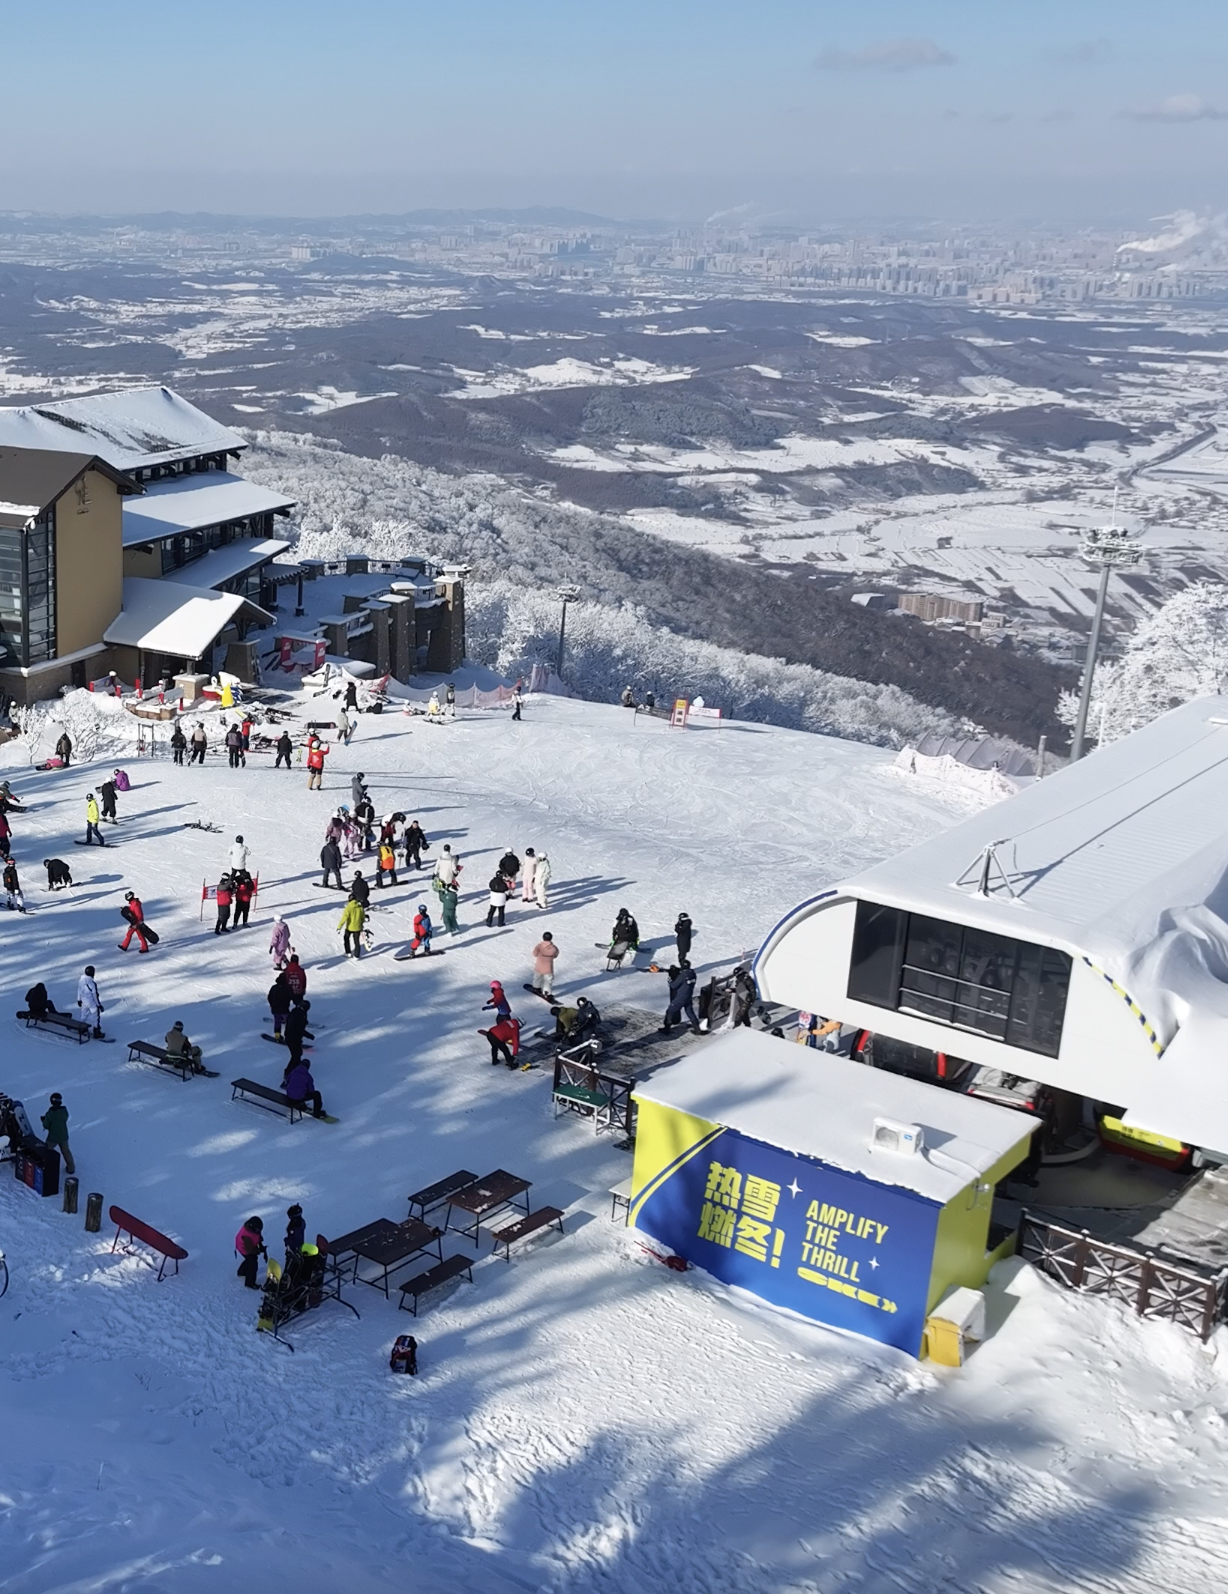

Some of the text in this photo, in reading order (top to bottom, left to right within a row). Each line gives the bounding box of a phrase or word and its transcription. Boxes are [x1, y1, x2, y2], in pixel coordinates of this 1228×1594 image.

[704, 1161, 781, 1222] 热雪
[805, 1199, 889, 1244] AMPLIFY
[805, 1220, 841, 1251] THE
[801, 1241, 860, 1283] THRILL
